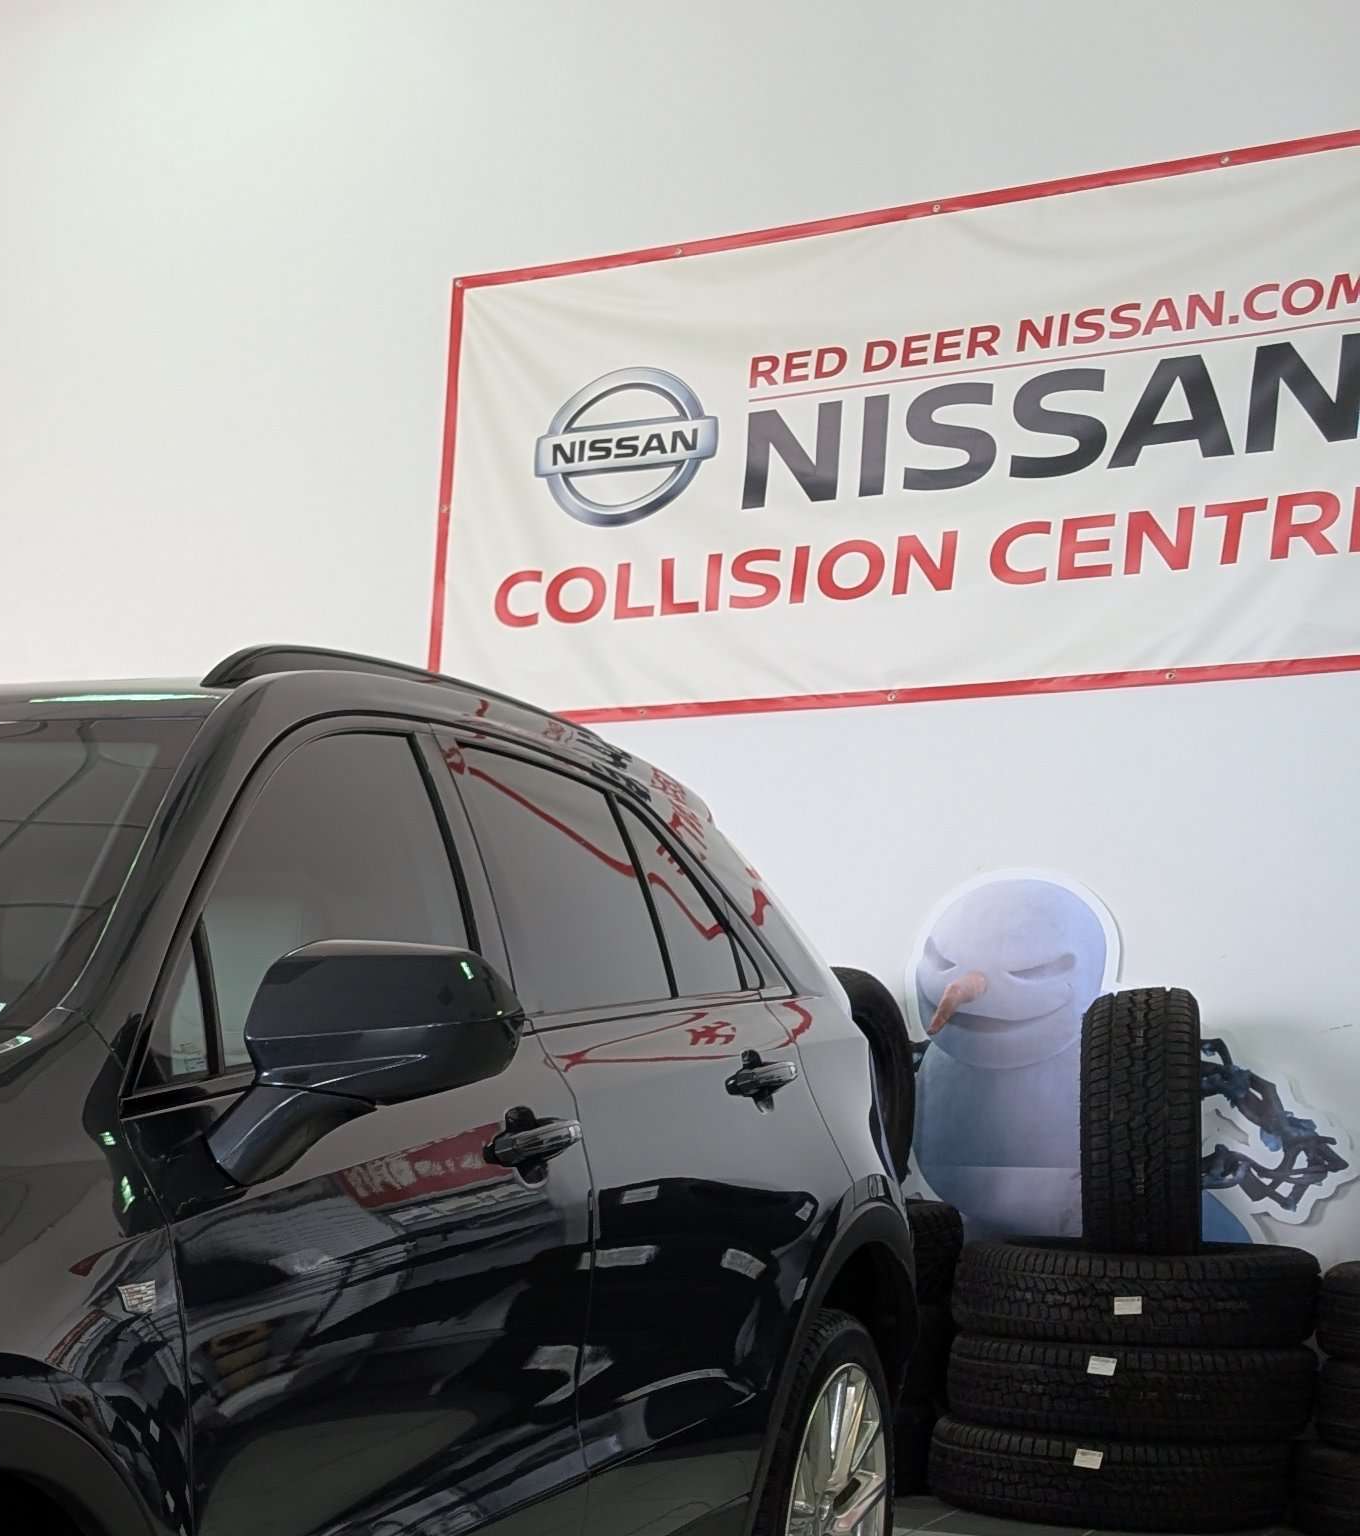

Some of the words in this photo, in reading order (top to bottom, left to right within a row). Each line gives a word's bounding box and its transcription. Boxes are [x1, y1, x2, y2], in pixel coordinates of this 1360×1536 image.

[748, 345, 848, 389] RED
[863, 324, 1002, 374] DEER
[1016, 271, 1360, 352] NISSAN.COM
[551, 427, 699, 466] NISSAN
[741, 332, 1360, 510] NISSAN
[492, 529, 959, 629] COLLISION
